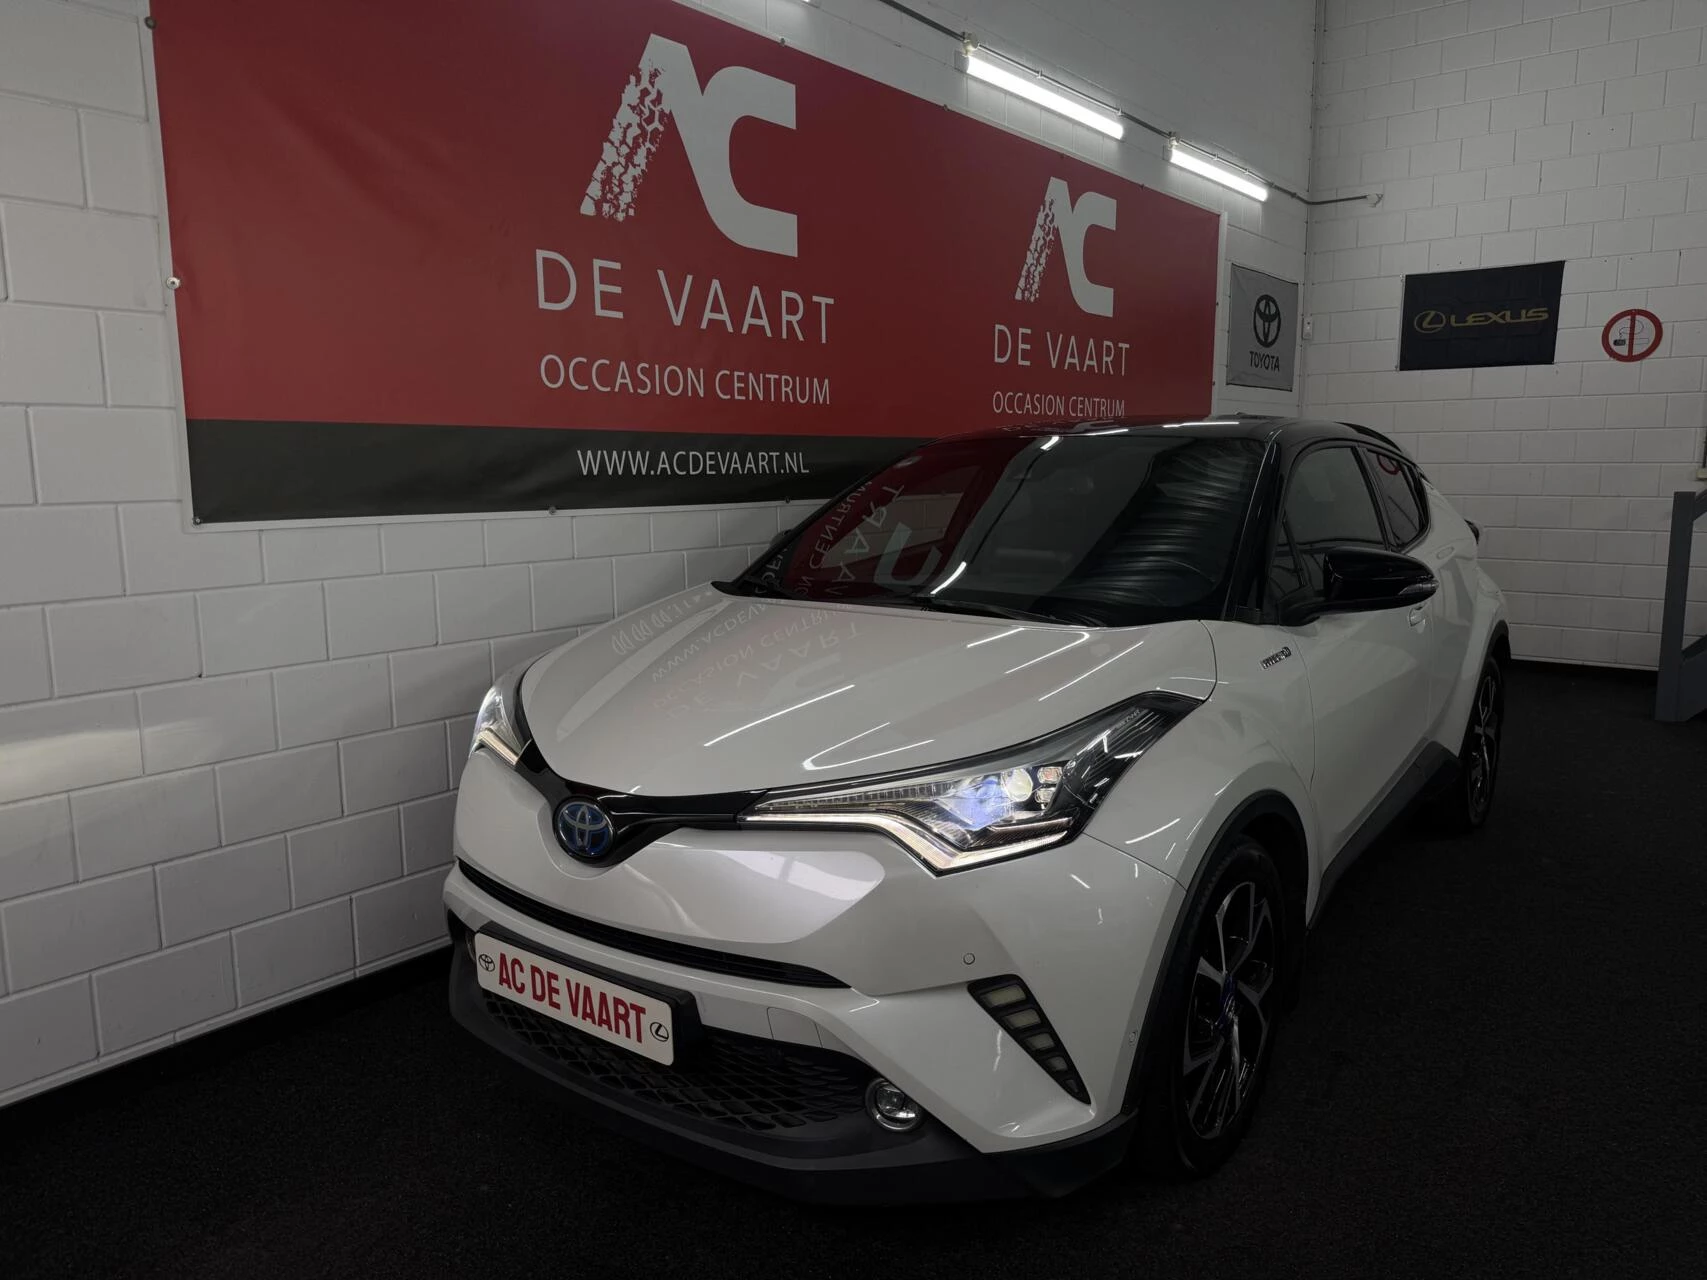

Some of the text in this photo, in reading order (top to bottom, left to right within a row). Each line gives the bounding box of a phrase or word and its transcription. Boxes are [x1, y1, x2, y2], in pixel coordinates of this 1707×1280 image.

[580, 33, 799, 258] AC
[1015, 176, 1117, 318] AC
[535, 248, 835, 344] DE VAART
[1450, 307, 1549, 327] LEXUS
[993, 323, 1130, 377] DE VAART
[1249, 350, 1281, 373] TOYOTA
[540, 354, 831, 405] OCCASION CENTRUM
[992, 391, 1126, 418] OCCASION CENTRUM
[577, 448, 810, 477] WWW.ACDEVAART.NL
[498, 952, 647, 1044] AC DE VAART
